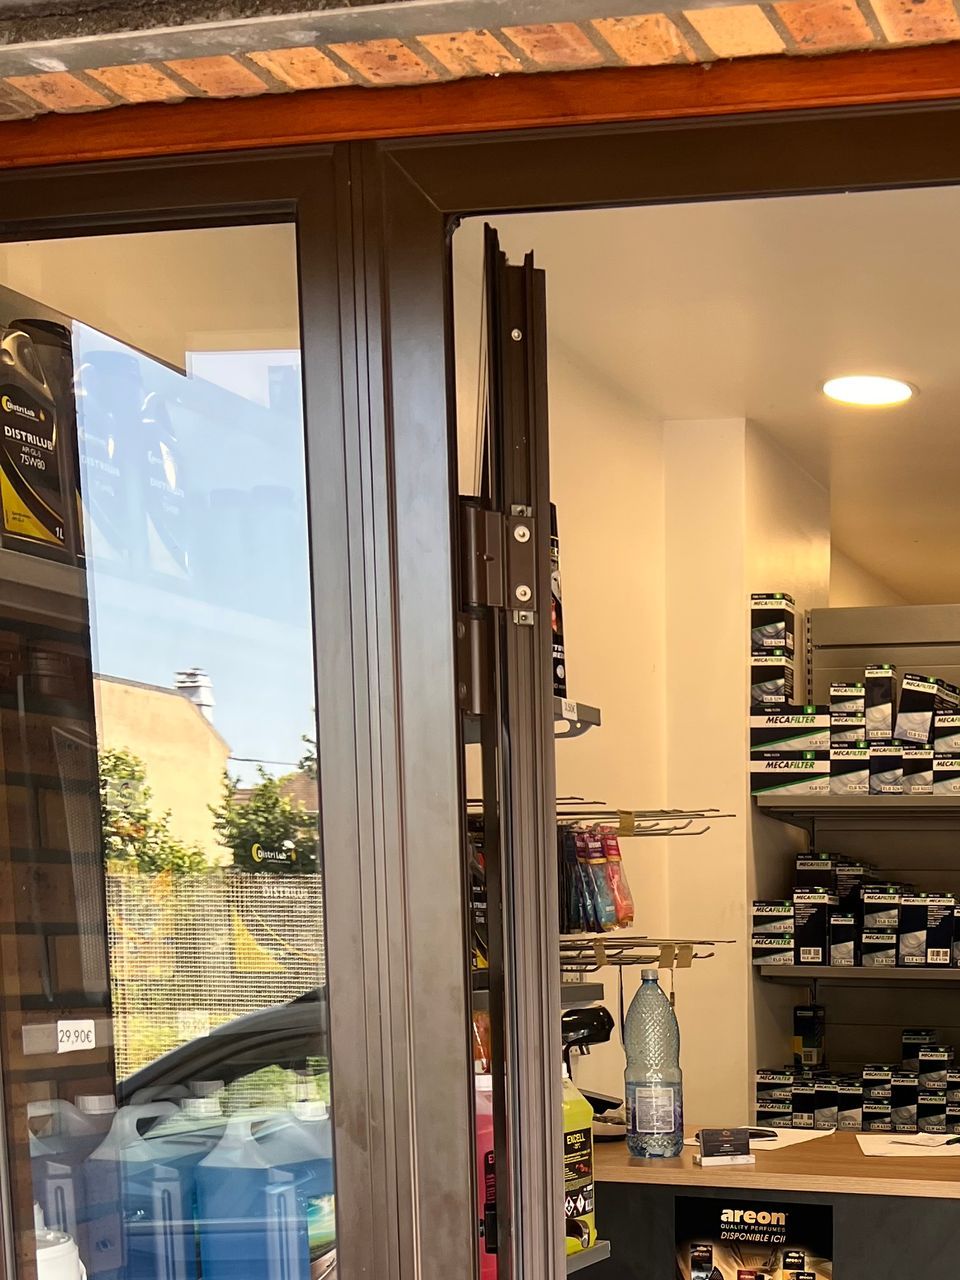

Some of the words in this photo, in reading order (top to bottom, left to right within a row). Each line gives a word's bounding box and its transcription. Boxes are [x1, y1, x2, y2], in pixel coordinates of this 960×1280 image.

[4, 425, 53, 450] DISTRILUB
[20, 453, 46, 471] 75W80
[55, 526, 64, 540] 1L
[905, 681, 936, 690] MECAFILTER
[766, 716, 815, 724] MECAFILTER
[59, 1030, 92, 1044] 29,90€
[566, 1133, 586, 1144] EXCELL
[721, 1209, 785, 1225] areon
[720, 1231, 769, 1242] DISPONIBLE
